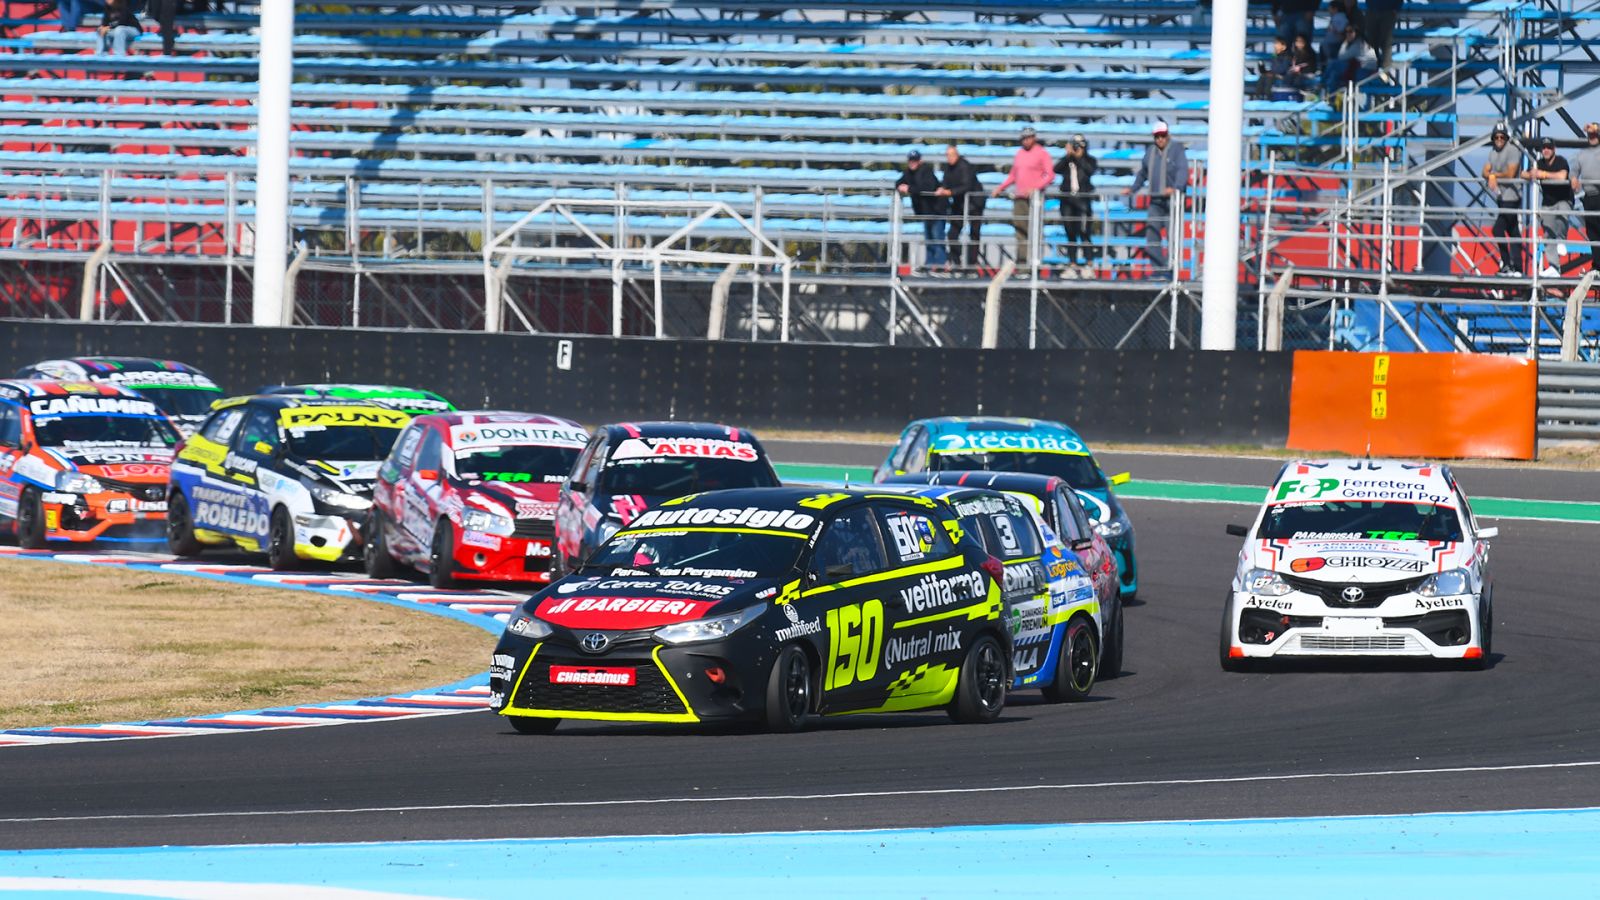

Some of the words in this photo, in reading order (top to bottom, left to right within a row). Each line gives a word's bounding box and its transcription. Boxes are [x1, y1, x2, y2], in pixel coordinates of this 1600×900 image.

[560, 344, 568, 364] F
[1378, 358, 1386, 368] F
[30, 396, 157, 415] CAÑUMIR
[290, 412, 404, 424] PAUNY
[480, 428, 528, 440] DON
[532, 429, 588, 443] ITALO
[655, 444, 756, 459] ARIAS
[1343, 478, 1425, 490] Ferretera
[1342, 488, 1413, 500] General
[1418, 492, 1450, 504] Paz
[194, 501, 270, 536] ROBLEDO
[630, 507, 814, 530] Autosiglo
[996, 516, 1016, 549] 3
[1292, 532, 1362, 540] PARABRISAS
[526, 542, 550, 556] Mo
[681, 567, 758, 578] Pergamino
[598, 580, 662, 590] Ceres
[664, 580, 735, 596] Tolvas
[900, 570, 986, 614] vetifarma
[575, 598, 696, 616] BARBIERI
[1246, 596, 1293, 610] Ayelen
[1415, 598, 1464, 610] Ayelen
[775, 616, 822, 642] multifeed
[1022, 616, 1048, 632] PREMIUM
[824, 599, 884, 692] 150
[888, 630, 932, 664] Nutral
[934, 626, 962, 653] mix
[557, 671, 630, 685] CHASCOMUS
